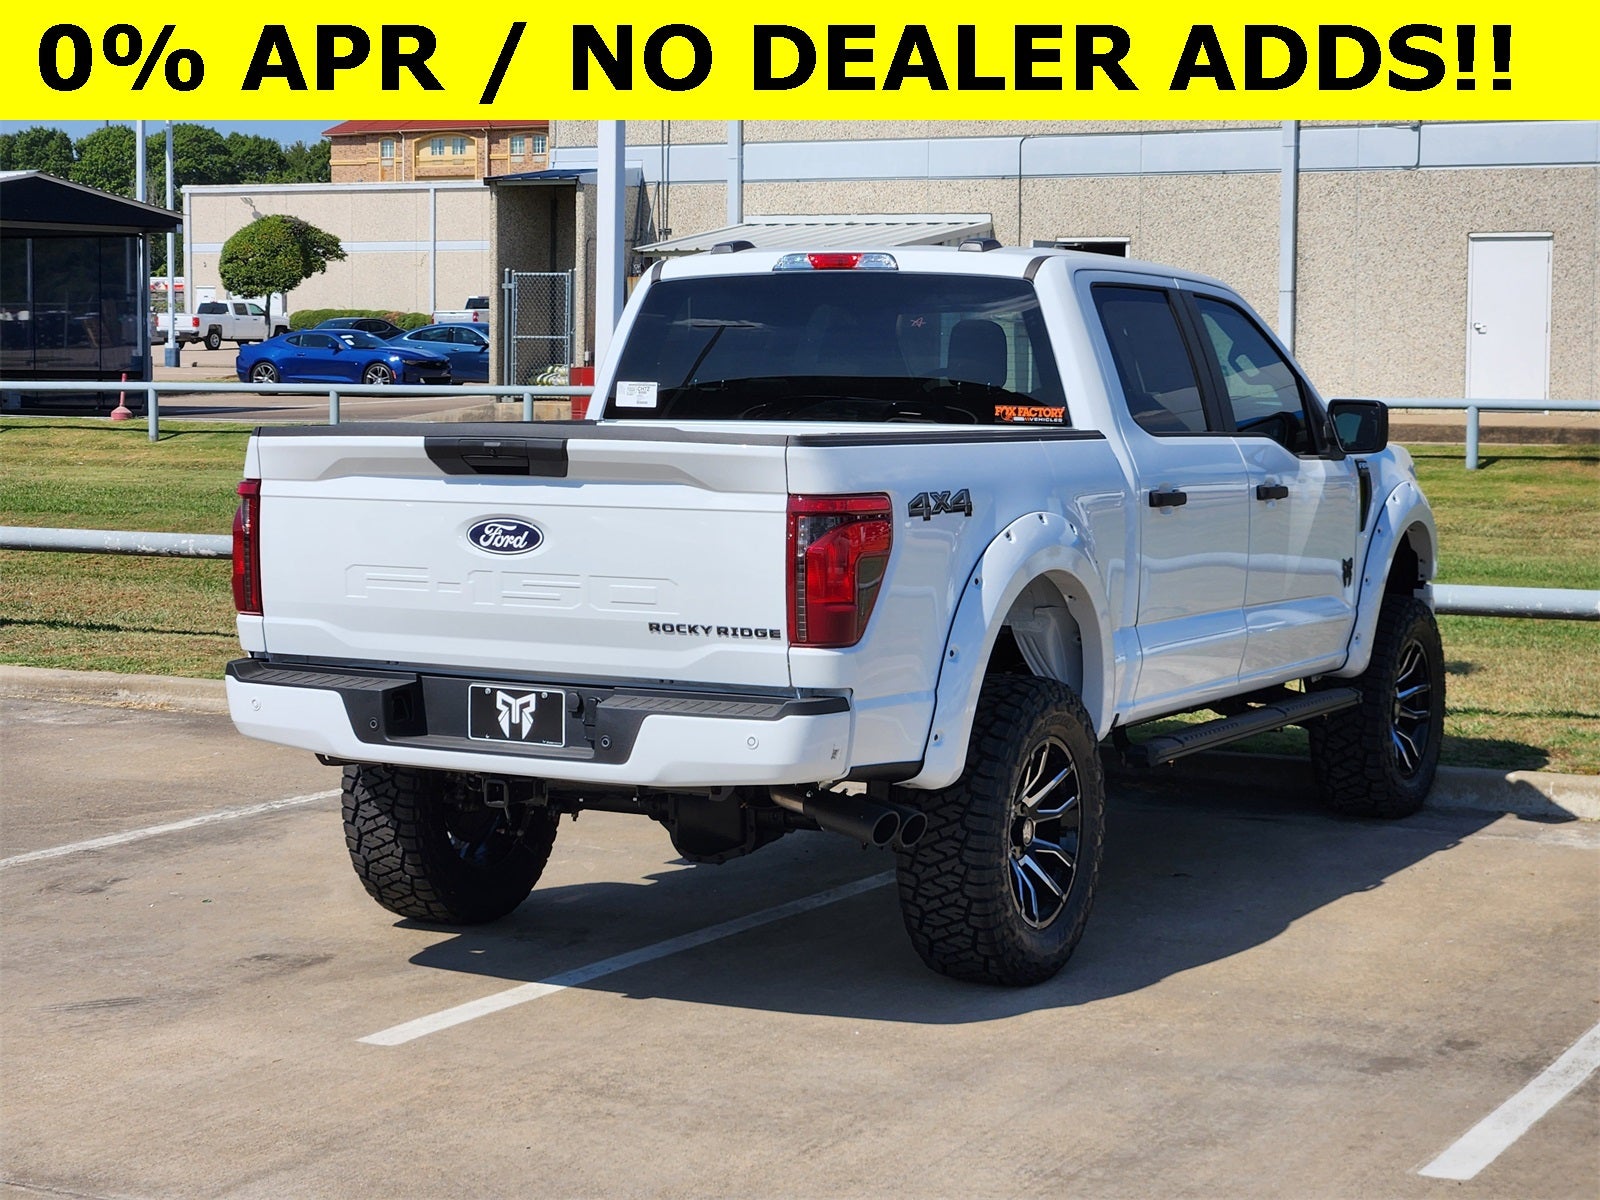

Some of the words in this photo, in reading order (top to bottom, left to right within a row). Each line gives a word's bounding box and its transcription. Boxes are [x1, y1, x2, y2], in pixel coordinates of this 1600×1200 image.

[994, 405, 1017, 417] FOX
[1017, 406, 1065, 418] FACTORY
[479, 523, 528, 549] Ford
[344, 562, 680, 616] F-150
[648, 621, 713, 636] ROCKY
[716, 625, 782, 641] RIDGE
